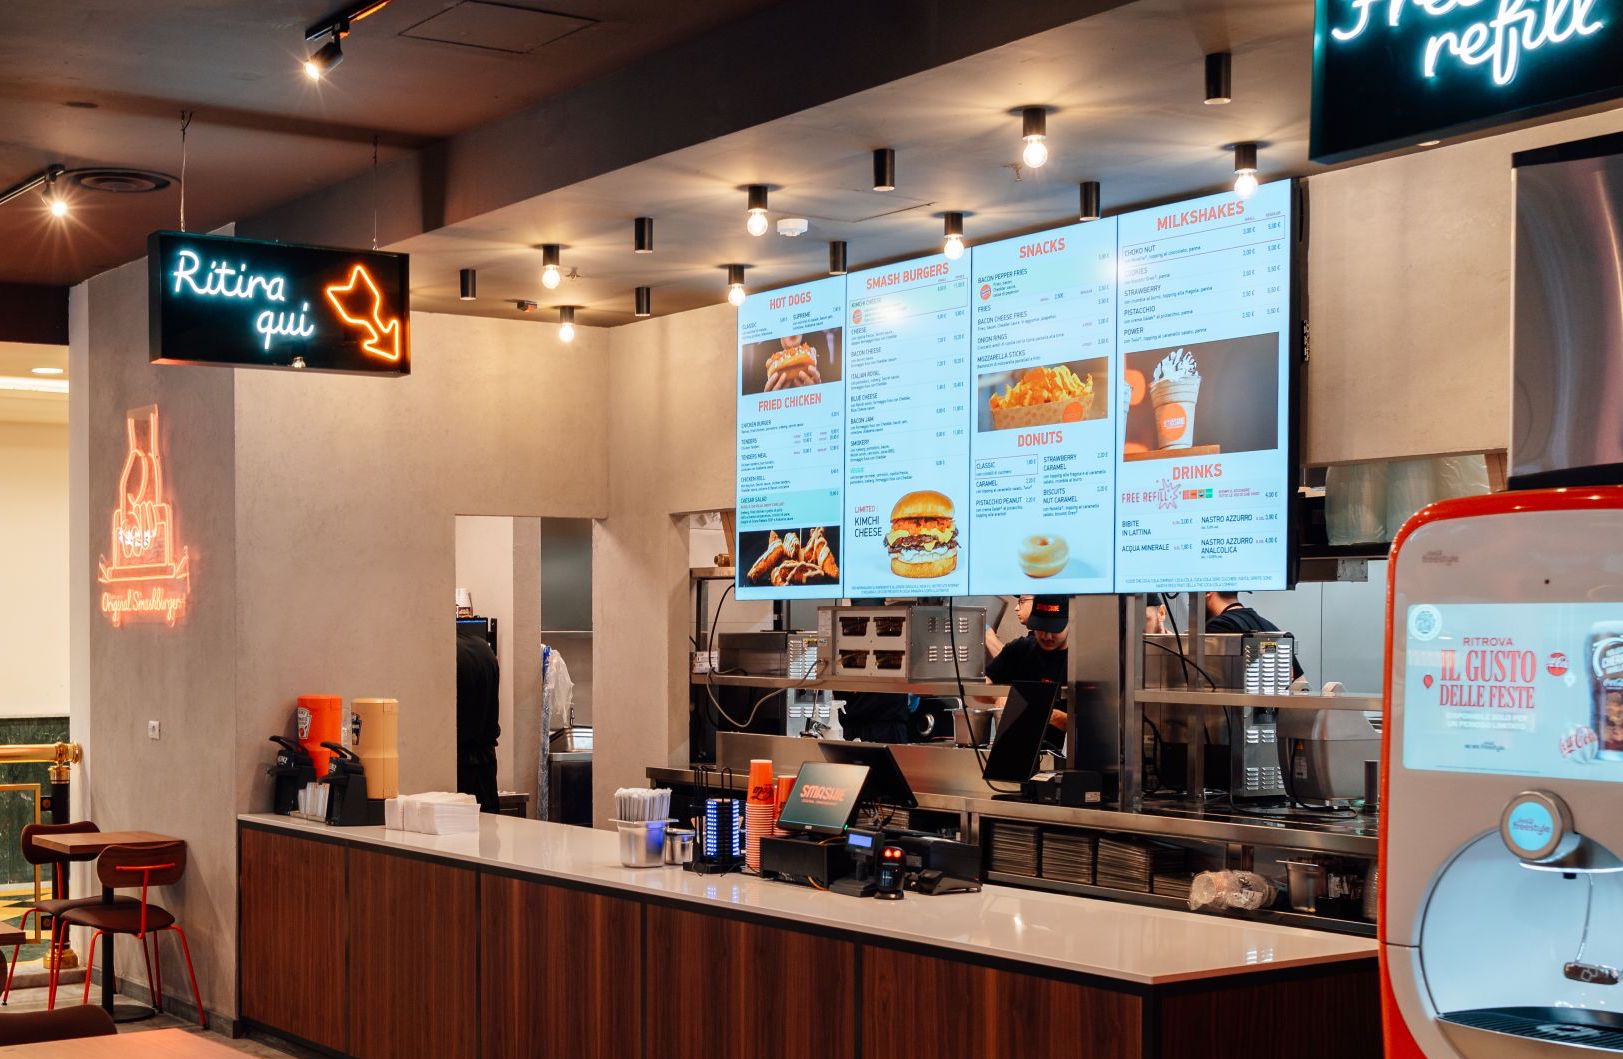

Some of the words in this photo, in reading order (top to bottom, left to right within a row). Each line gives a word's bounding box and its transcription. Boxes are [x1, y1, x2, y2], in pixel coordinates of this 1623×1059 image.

[1424, 0, 1604, 85] refill
[1156, 200, 1245, 231] MILKSHAKES
[1020, 238, 1066, 258] SNACKS
[1144, 245, 1156, 253] NUT
[173, 250, 285, 301] Ritira
[866, 272, 900, 290] SMASH
[902, 262, 950, 282] BURGERS
[978, 276, 994, 284] BACON
[995, 271, 1012, 280] PEPPER
[1014, 268, 1028, 276] FRIES
[1124, 285, 1161, 296] STRAWBERRY
[770, 297, 786, 310] HOT
[788, 292, 812, 306] DOGS
[793, 312, 810, 320] SUPREME
[1124, 306, 1156, 316] PISTACCHIO
[995, 314, 1012, 322] CHEESE
[256, 302, 315, 350] qui
[852, 327, 866, 335] CHEESE
[1124, 327, 1144, 336] POWER
[978, 352, 1008, 362] MOZZARELLA
[758, 398, 782, 413] FRIED
[784, 392, 821, 409] CHICKEN
[1018, 431, 1063, 448] DONUTS
[1044, 454, 1077, 462] STRAWBERRY
[976, 462, 996, 470] CLASSIC
[1172, 463, 1222, 480] DRINKS
[976, 480, 998, 488] CARAMEL
[1044, 488, 1066, 496] BISCUITS
[1122, 492, 1140, 503] FREE
[1142, 491, 1168, 502] REFILL
[854, 506, 876, 514] LIMITED
[854, 516, 880, 526] KIMCHI
[854, 527, 882, 538] CHEESE
[1122, 544, 1140, 552] ACQUA
[102, 589, 132, 622] Original
[1463, 637, 1513, 646] RITROVA
[1440, 650, 1460, 682] IL
[1465, 650, 1537, 683] GUSTO
[1440, 684, 1485, 708] DELLE
[1490, 686, 1536, 708] FESTE
